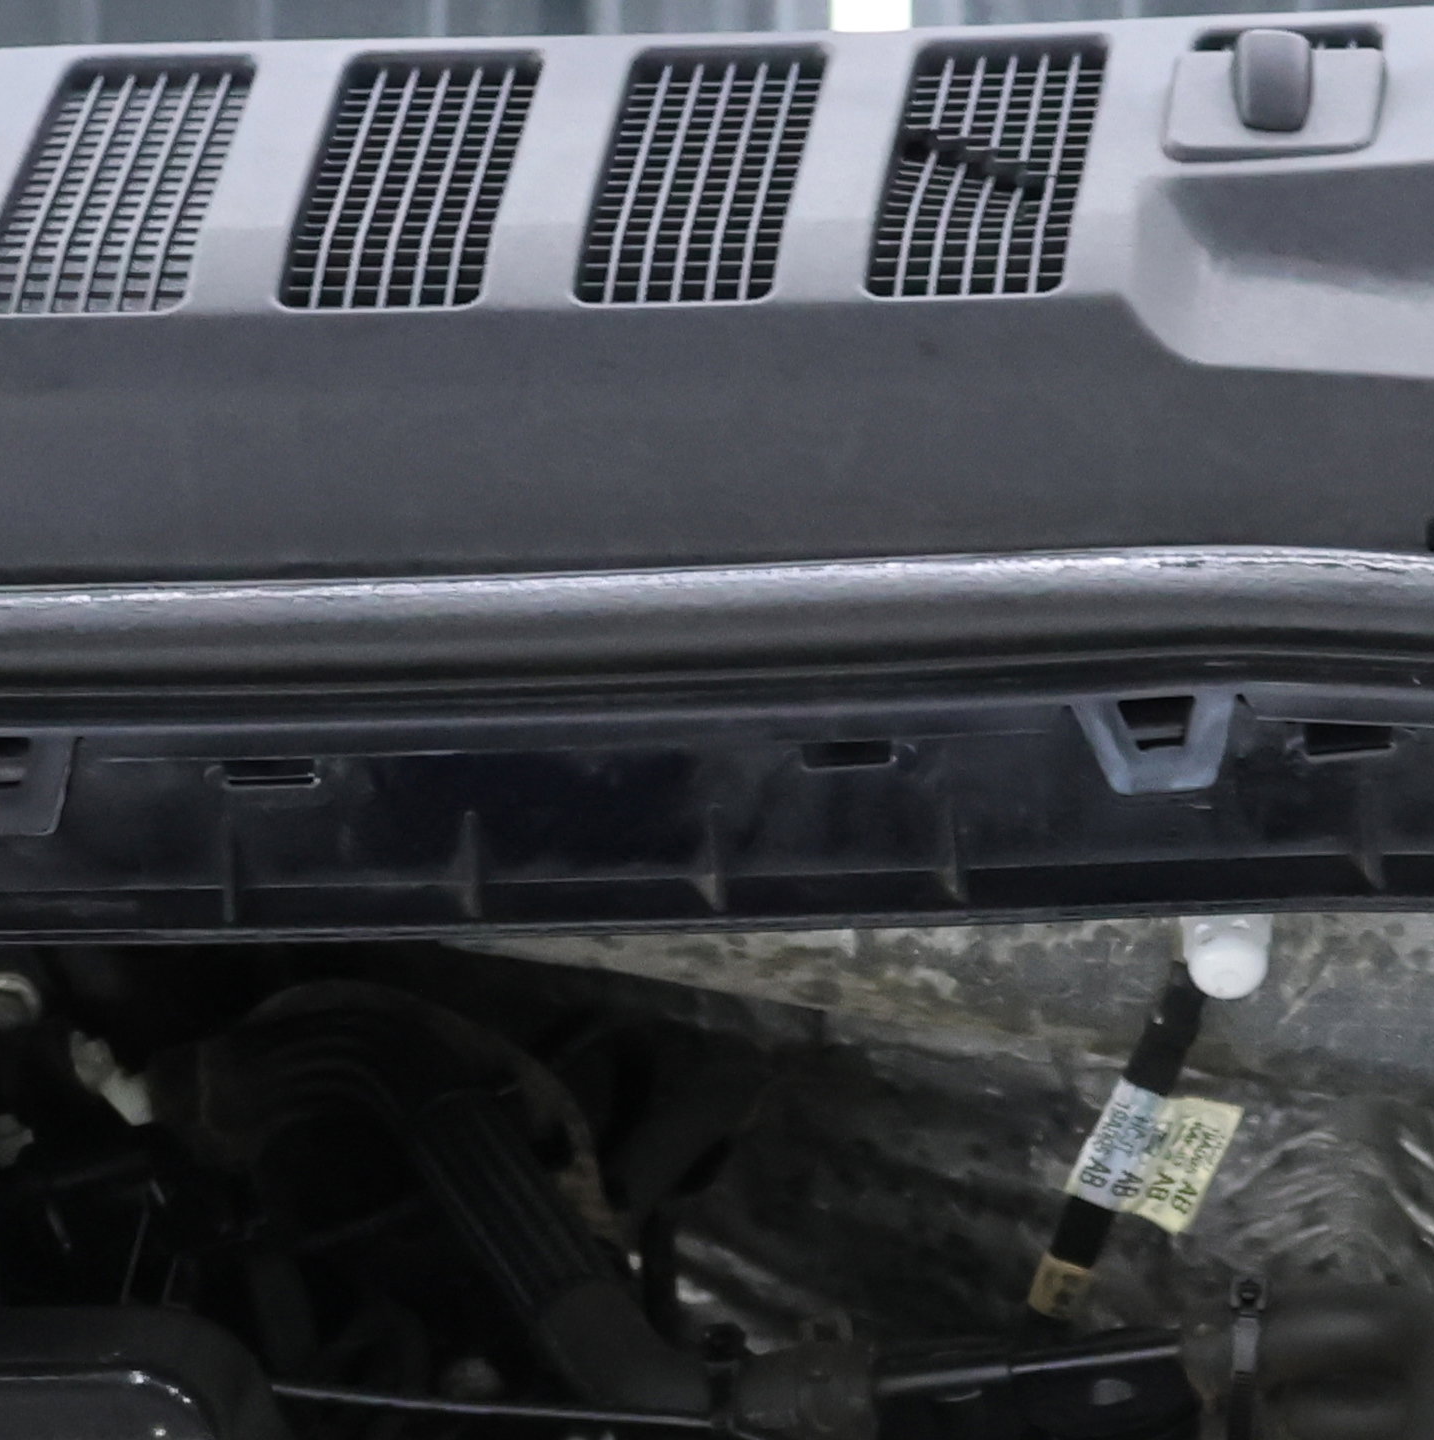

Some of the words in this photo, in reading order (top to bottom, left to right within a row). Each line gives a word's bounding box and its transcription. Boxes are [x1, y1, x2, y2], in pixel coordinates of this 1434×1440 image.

[1080, 1156, 1111, 1189] AB
[1146, 1171, 1175, 1202] AB
[1170, 1181, 1198, 1214] AB
